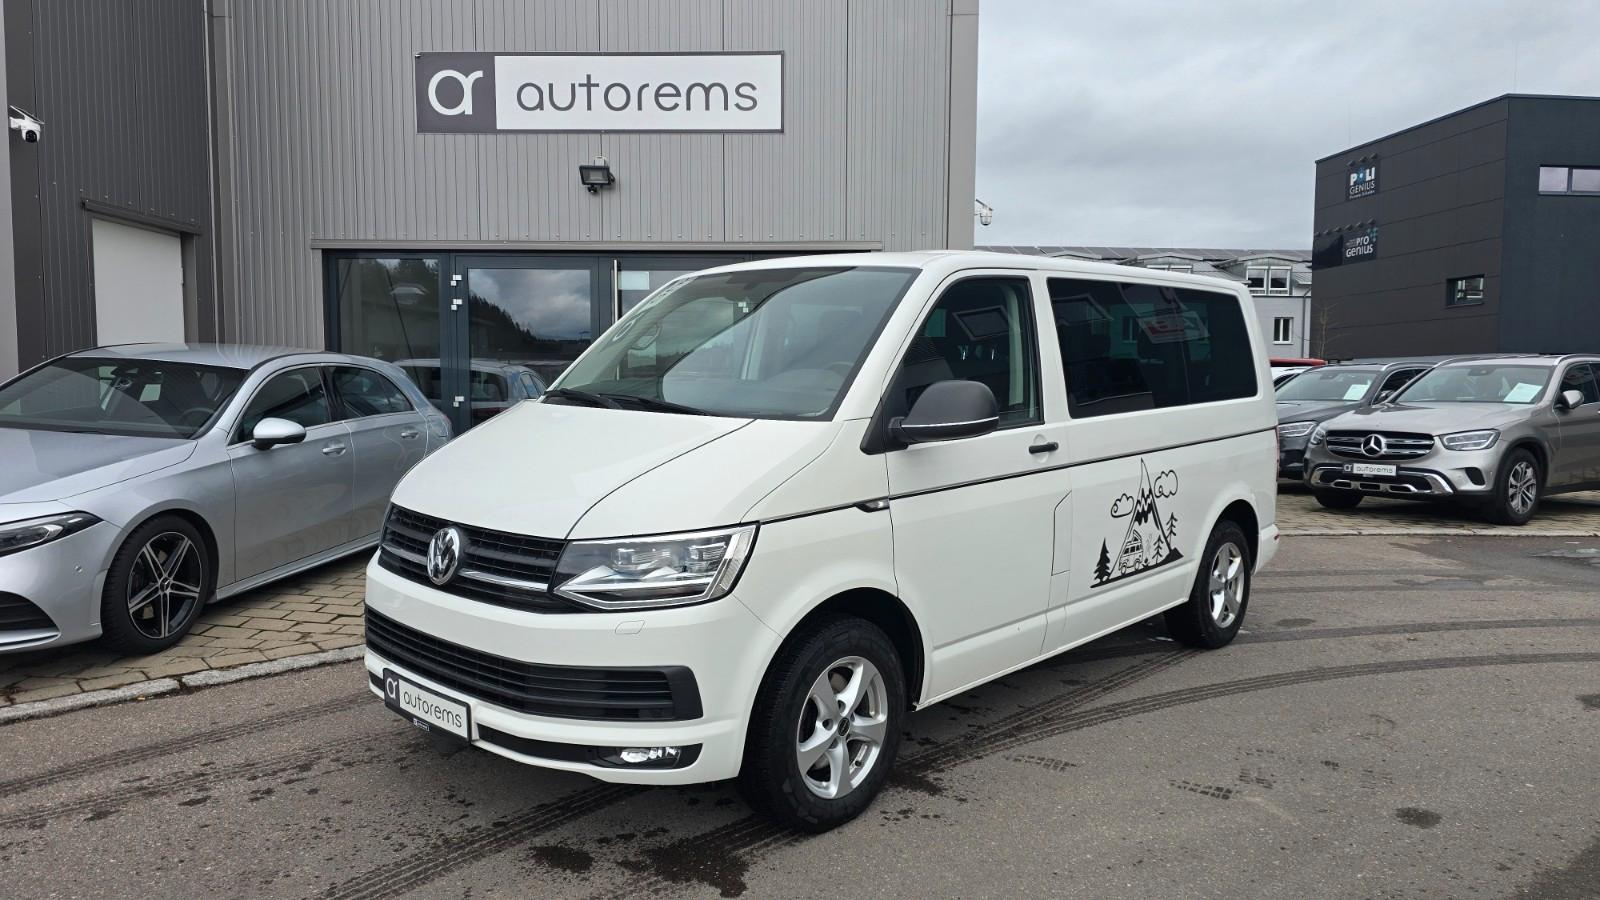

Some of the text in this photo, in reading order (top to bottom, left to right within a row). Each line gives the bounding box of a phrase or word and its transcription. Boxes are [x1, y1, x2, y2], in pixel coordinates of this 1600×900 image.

[516, 73, 758, 112] autorems
[1349, 180, 1376, 195] GENIUS
[403, 691, 463, 729] autorems
